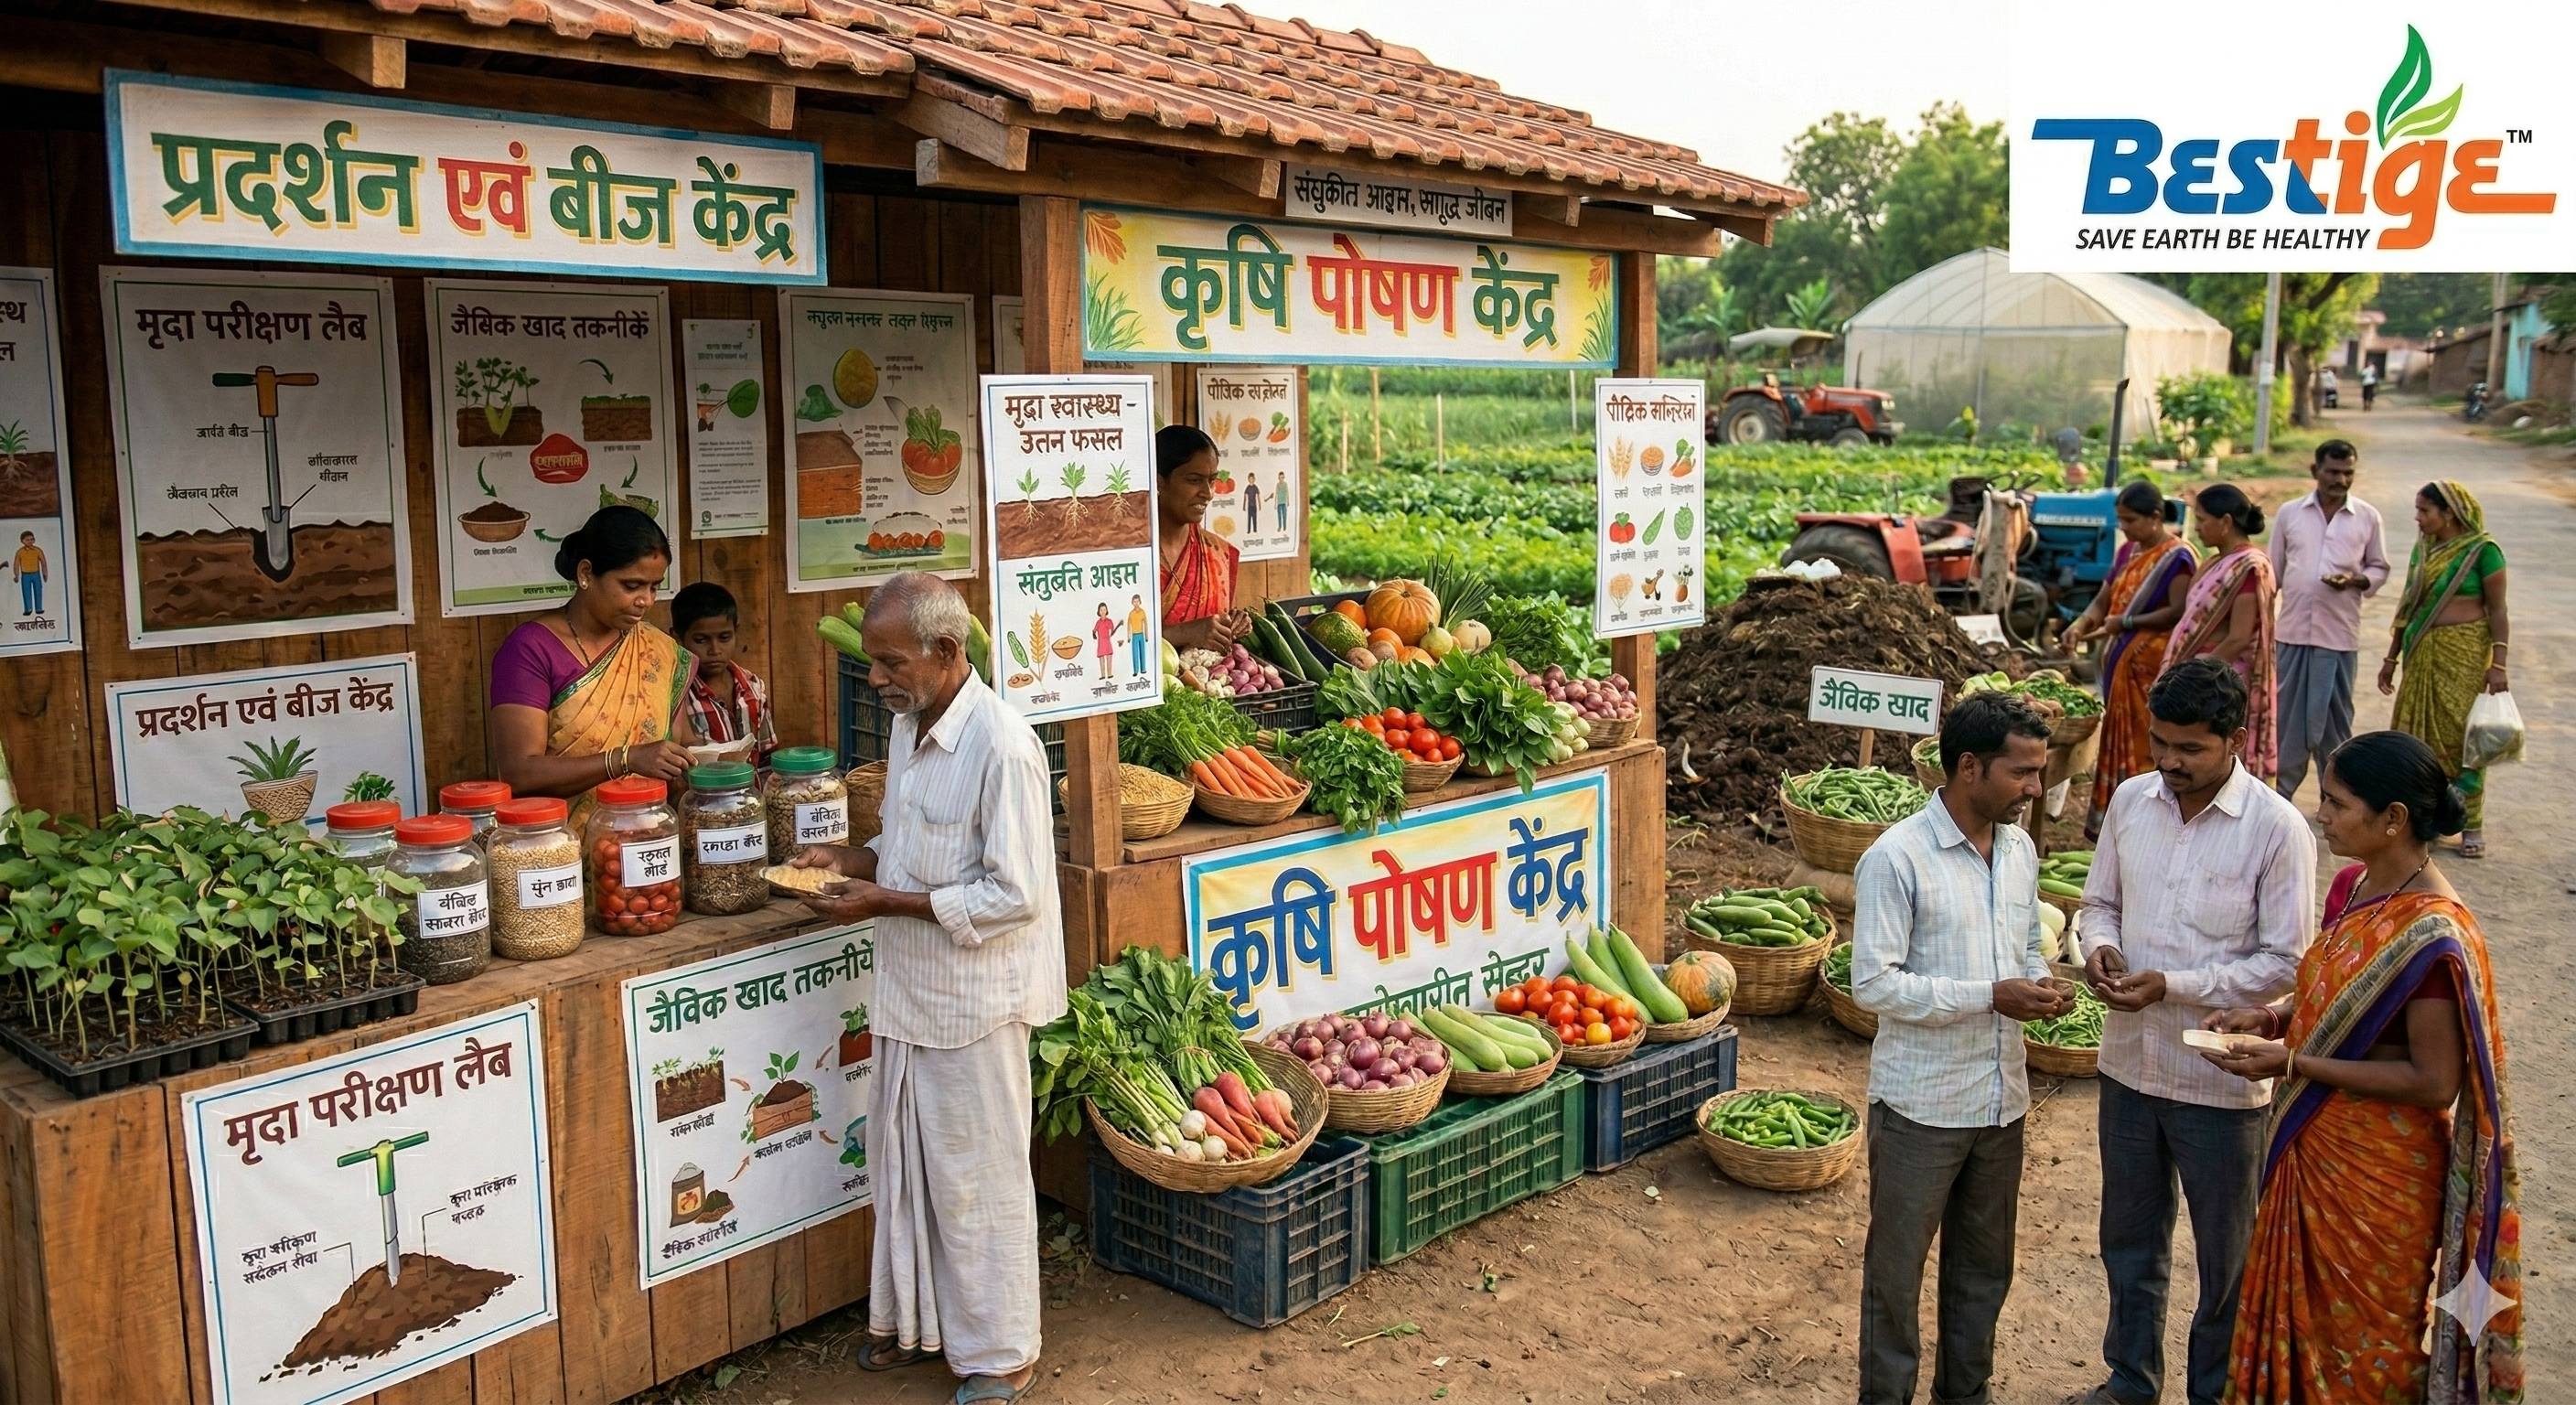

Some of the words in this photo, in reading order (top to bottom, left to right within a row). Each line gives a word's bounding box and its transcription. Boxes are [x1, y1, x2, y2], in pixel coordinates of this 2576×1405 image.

[152, 120, 423, 234] प्रदर्शन
[438, 141, 532, 238] एवं
[547, 145, 677, 248] बीज
[691, 156, 798, 264] केंद्र
[135, 308, 195, 349] मृदा
[202, 300, 312, 344] परीक्षण
[319, 301, 368, 341] लैब
[521, 316, 566, 339] खाद
[1156, 223, 1294, 351] कृषि
[1306, 233, 1461, 335] पोषण
[1471, 245, 1560, 349] केंद्र
[135, 693, 228, 737] प्रदर्शन
[236, 688, 277, 724] एवं
[284, 682, 340, 718] बीज
[348, 677, 393, 713] केंद्र
[1207, 866, 1336, 1032] कृषि
[1347, 849, 1499, 961] पोषण
[1507, 817, 1589, 922] केंद्र
[646, 988, 728, 1034] जैविक
[735, 971, 788, 1010] खाद
[224, 1100, 299, 1166] मृदा
[309, 1061, 445, 1128] परीक्षण
[454, 1036, 512, 1089] लैब
